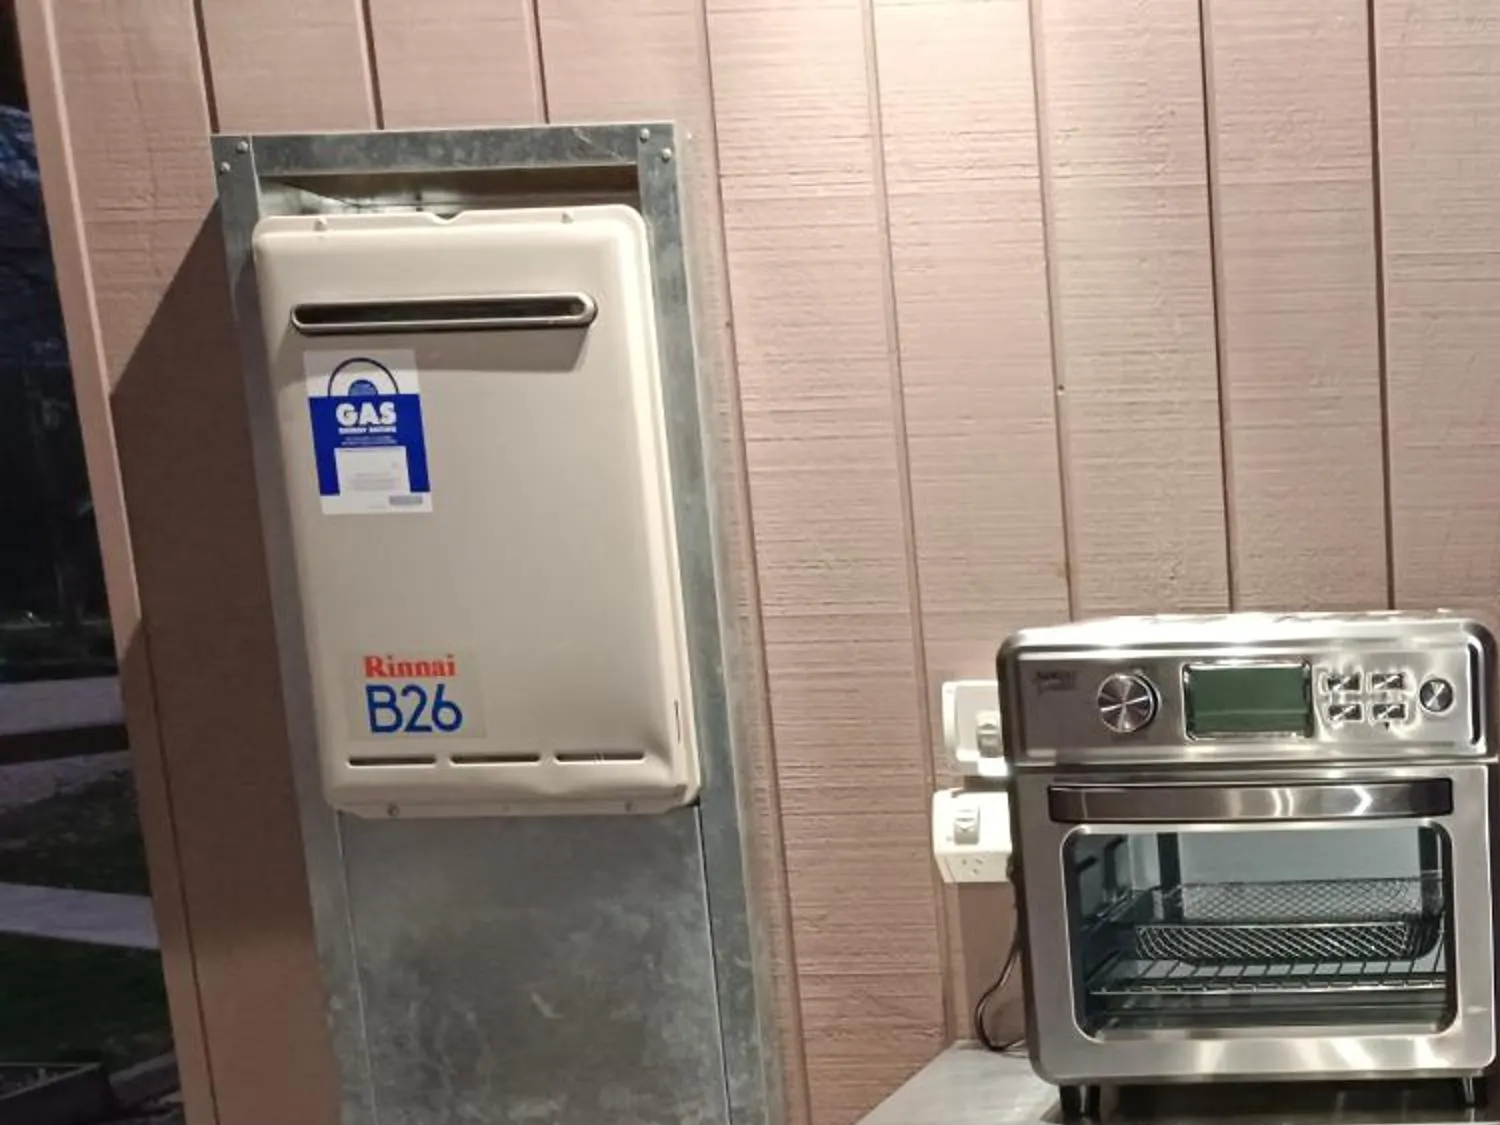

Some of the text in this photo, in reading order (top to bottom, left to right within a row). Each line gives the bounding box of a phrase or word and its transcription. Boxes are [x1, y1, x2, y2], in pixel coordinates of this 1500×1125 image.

[336, 401, 397, 427] GAS
[364, 654, 456, 678] Rinnai
[365, 683, 463, 733] B26
